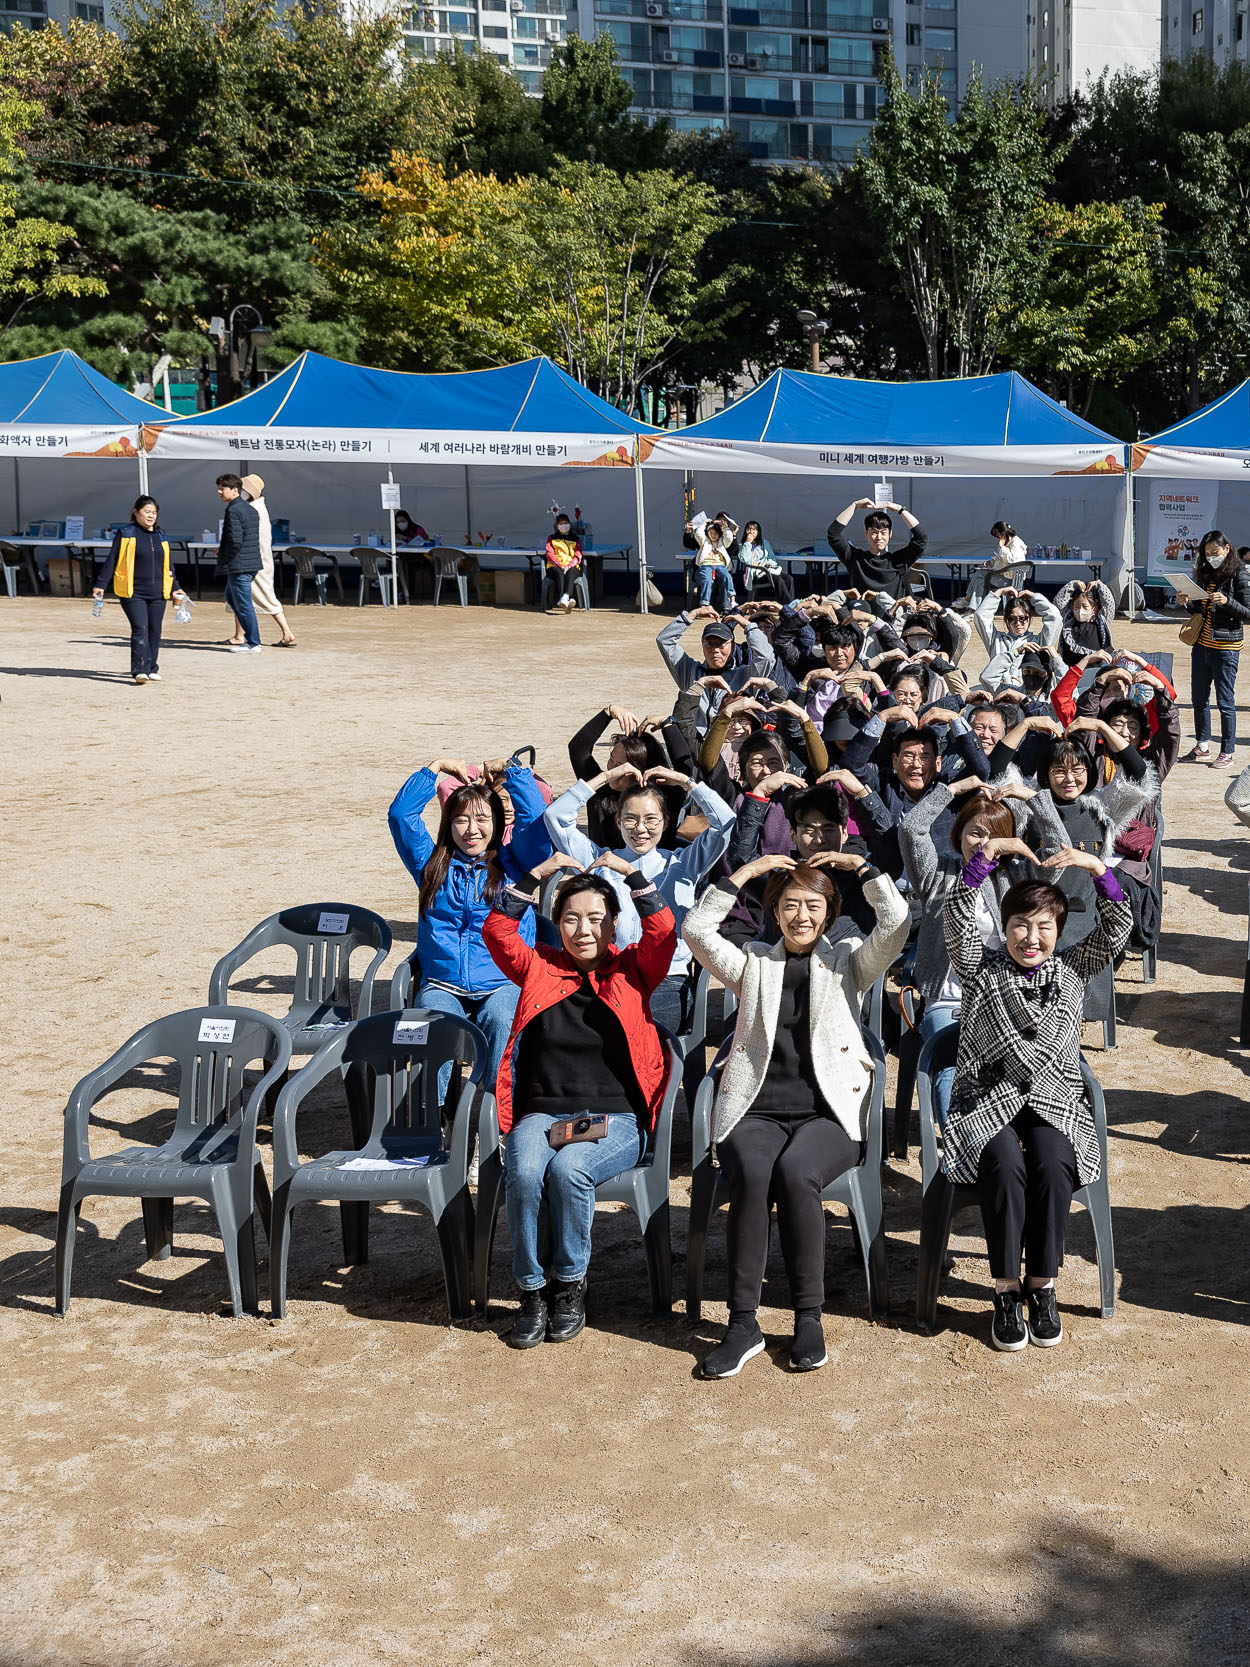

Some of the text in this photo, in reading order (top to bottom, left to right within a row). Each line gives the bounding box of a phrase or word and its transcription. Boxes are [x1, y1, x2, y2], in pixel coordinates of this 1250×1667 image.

[35, 436, 68, 447] 만들기
[229, 438, 372, 452] 베트남 전통모자(논라) 만들기
[419, 442, 568, 456] 세계 여러나라 바람개비 만들기
[819, 452, 945, 467] 미니 세계 여행가방 만들기
[1158, 494, 1199, 504] 지역네트워크
[1158, 503, 1186, 512] 협력사업
